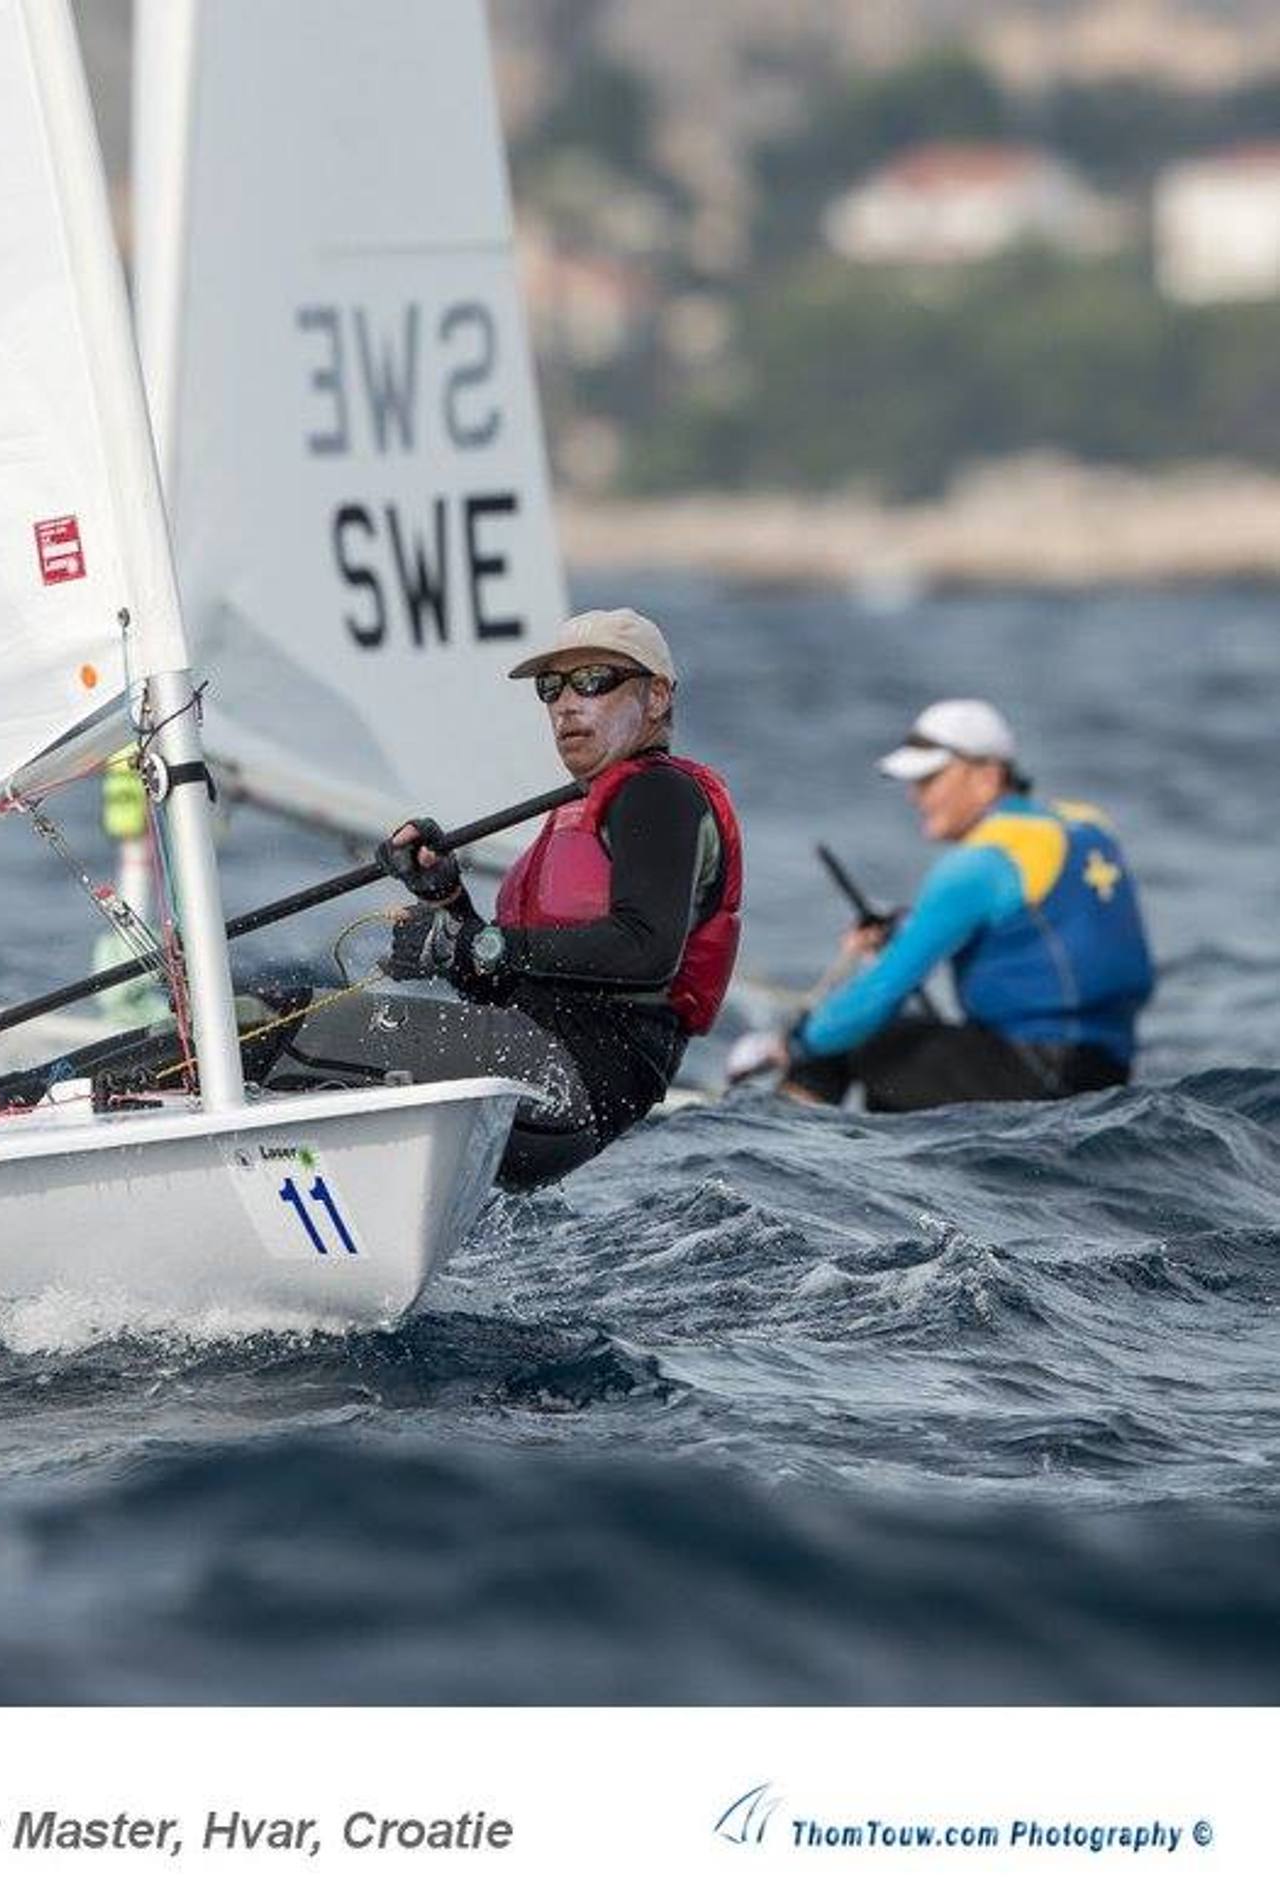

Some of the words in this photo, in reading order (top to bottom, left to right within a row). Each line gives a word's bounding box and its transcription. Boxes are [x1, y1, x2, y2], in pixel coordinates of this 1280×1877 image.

[333, 492, 527, 650] SWE
[259, 1145, 297, 1160] Laser
[278, 1175, 359, 1255] 11
